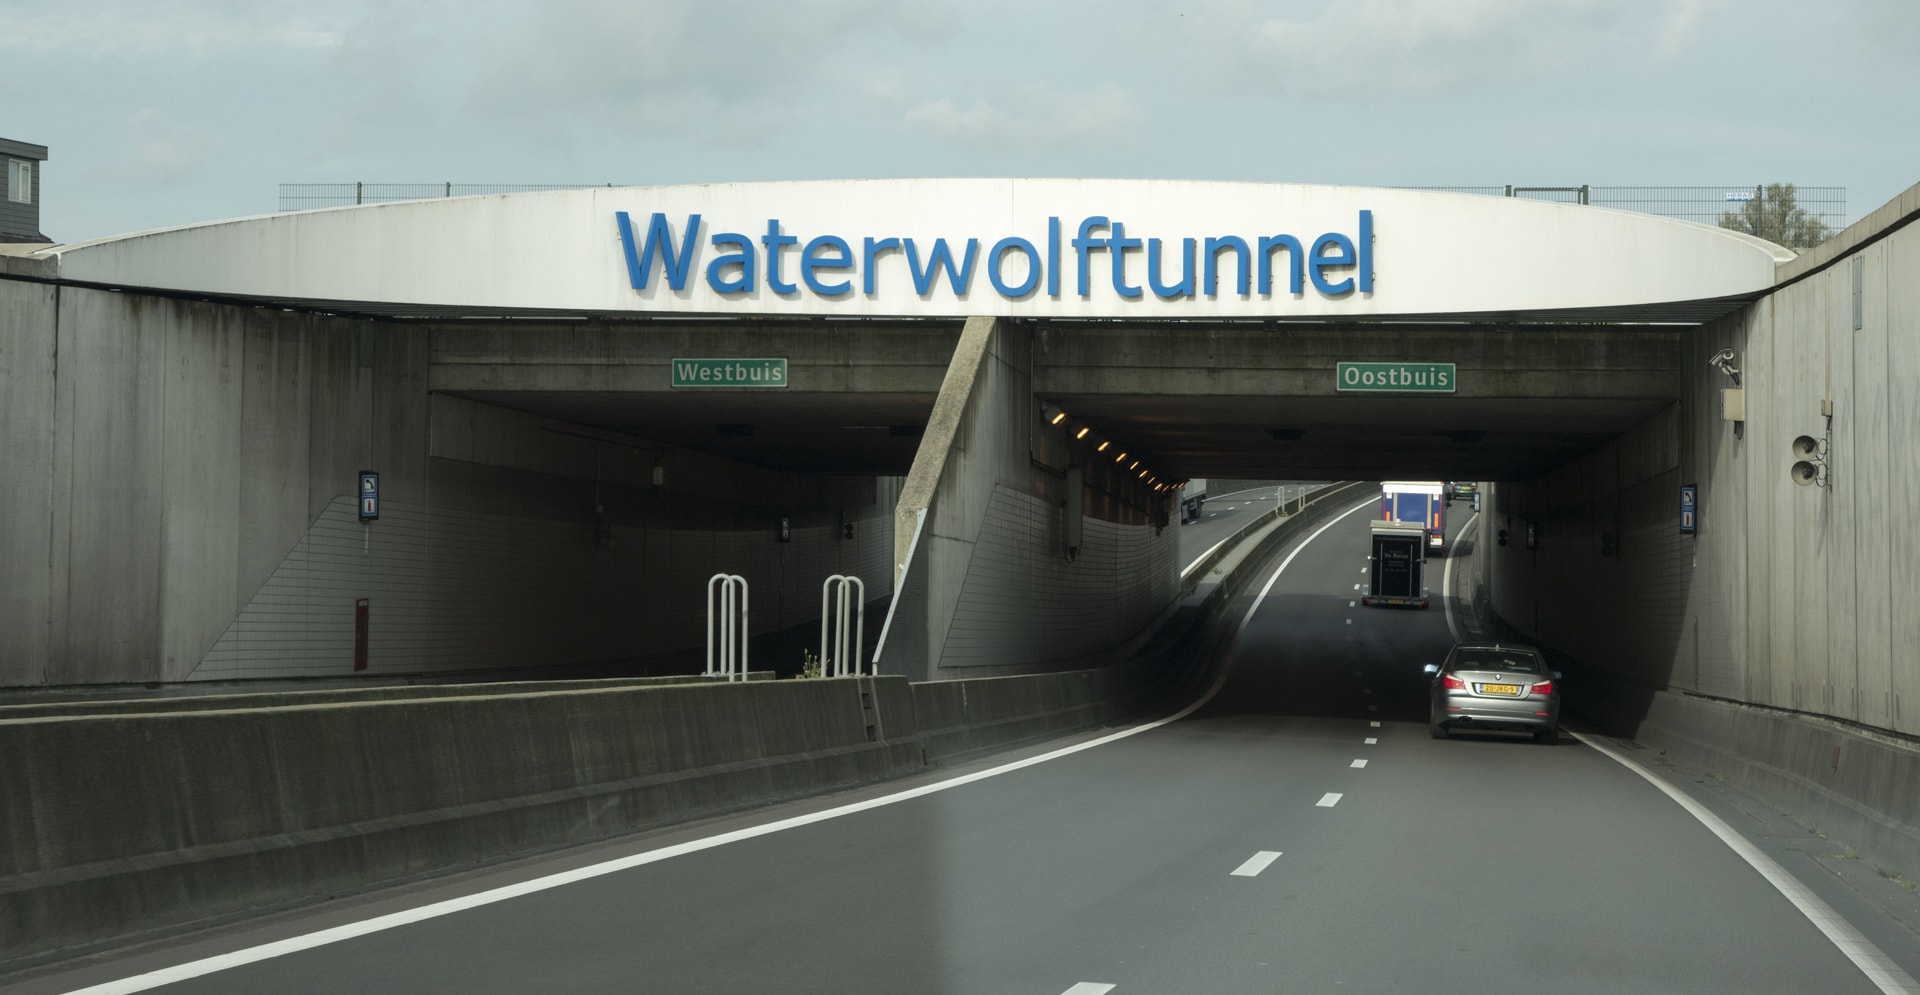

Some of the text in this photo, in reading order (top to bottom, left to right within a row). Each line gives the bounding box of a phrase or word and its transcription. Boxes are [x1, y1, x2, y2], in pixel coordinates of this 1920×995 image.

[615, 209, 1373, 297] Waterwolftunnel
[677, 362, 782, 381] Westbuis
[1344, 367, 1448, 386] Oostbuis
